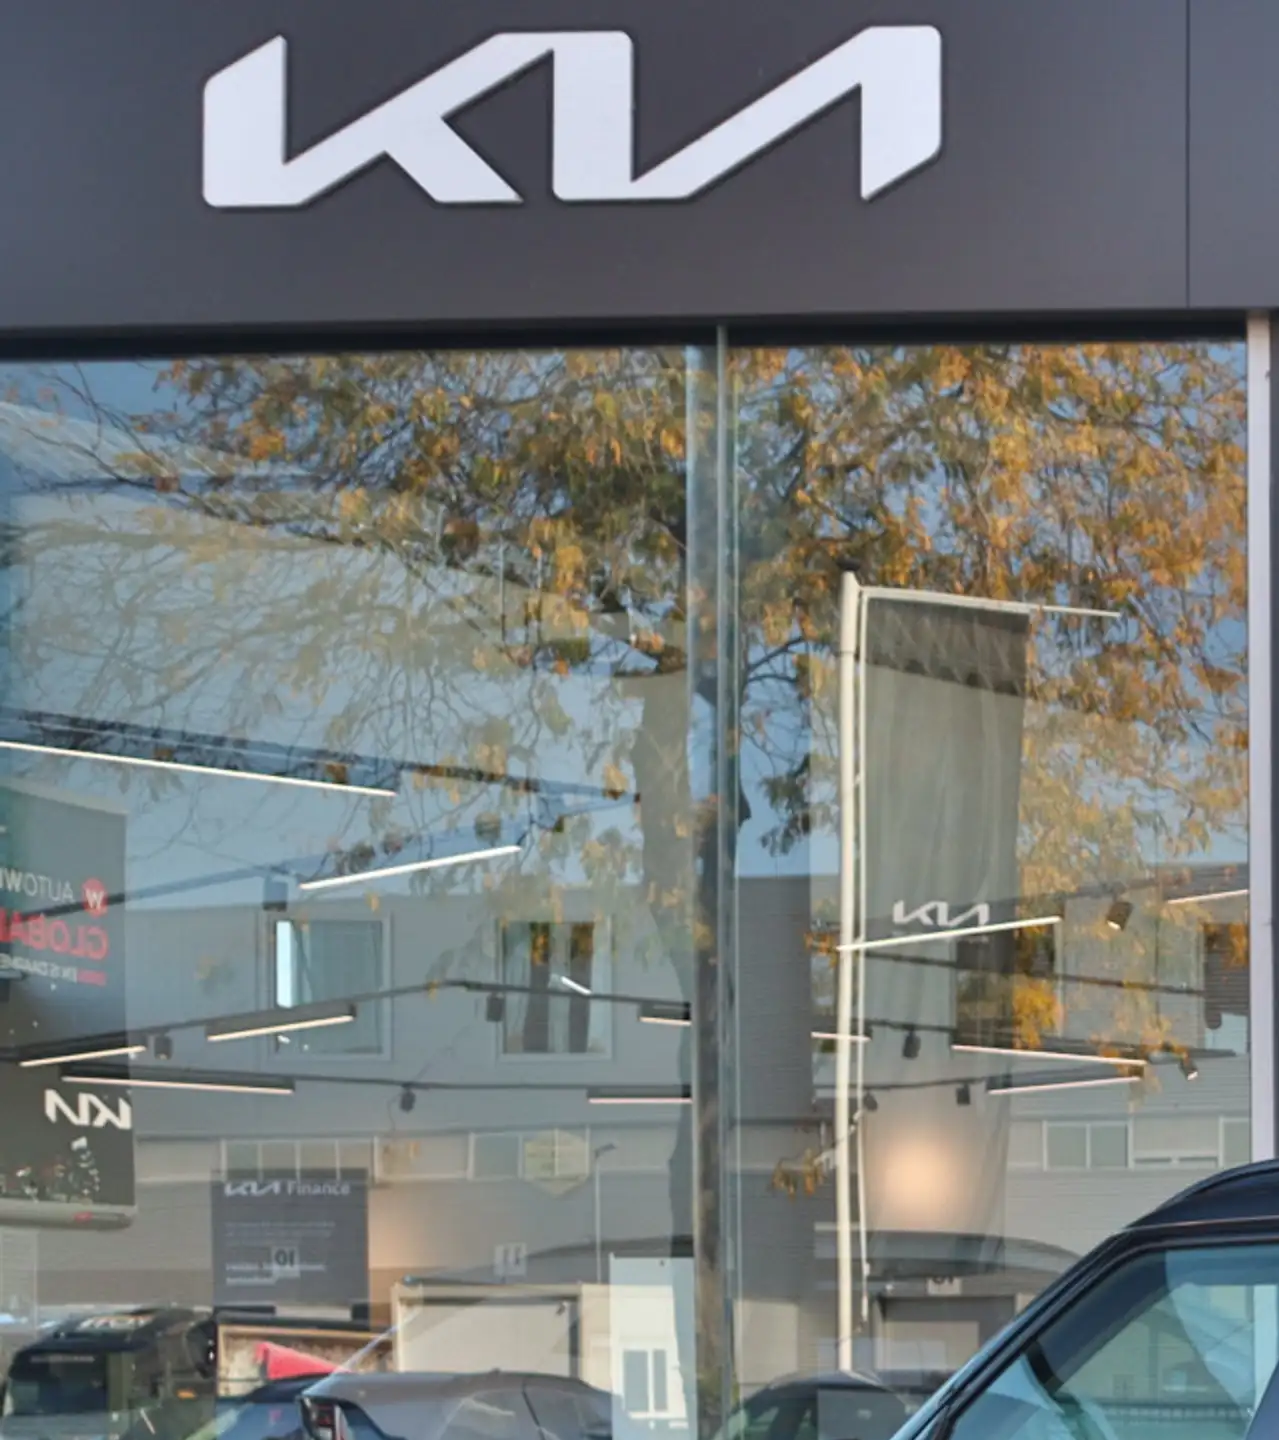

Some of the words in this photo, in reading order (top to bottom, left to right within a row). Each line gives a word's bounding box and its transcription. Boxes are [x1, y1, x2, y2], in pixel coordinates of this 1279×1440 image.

[203, 25, 942, 207] KIA
[892, 899, 990, 927] KIA
[224, 1180, 281, 1197] KIA
[287, 1181, 351, 1197] Finance
